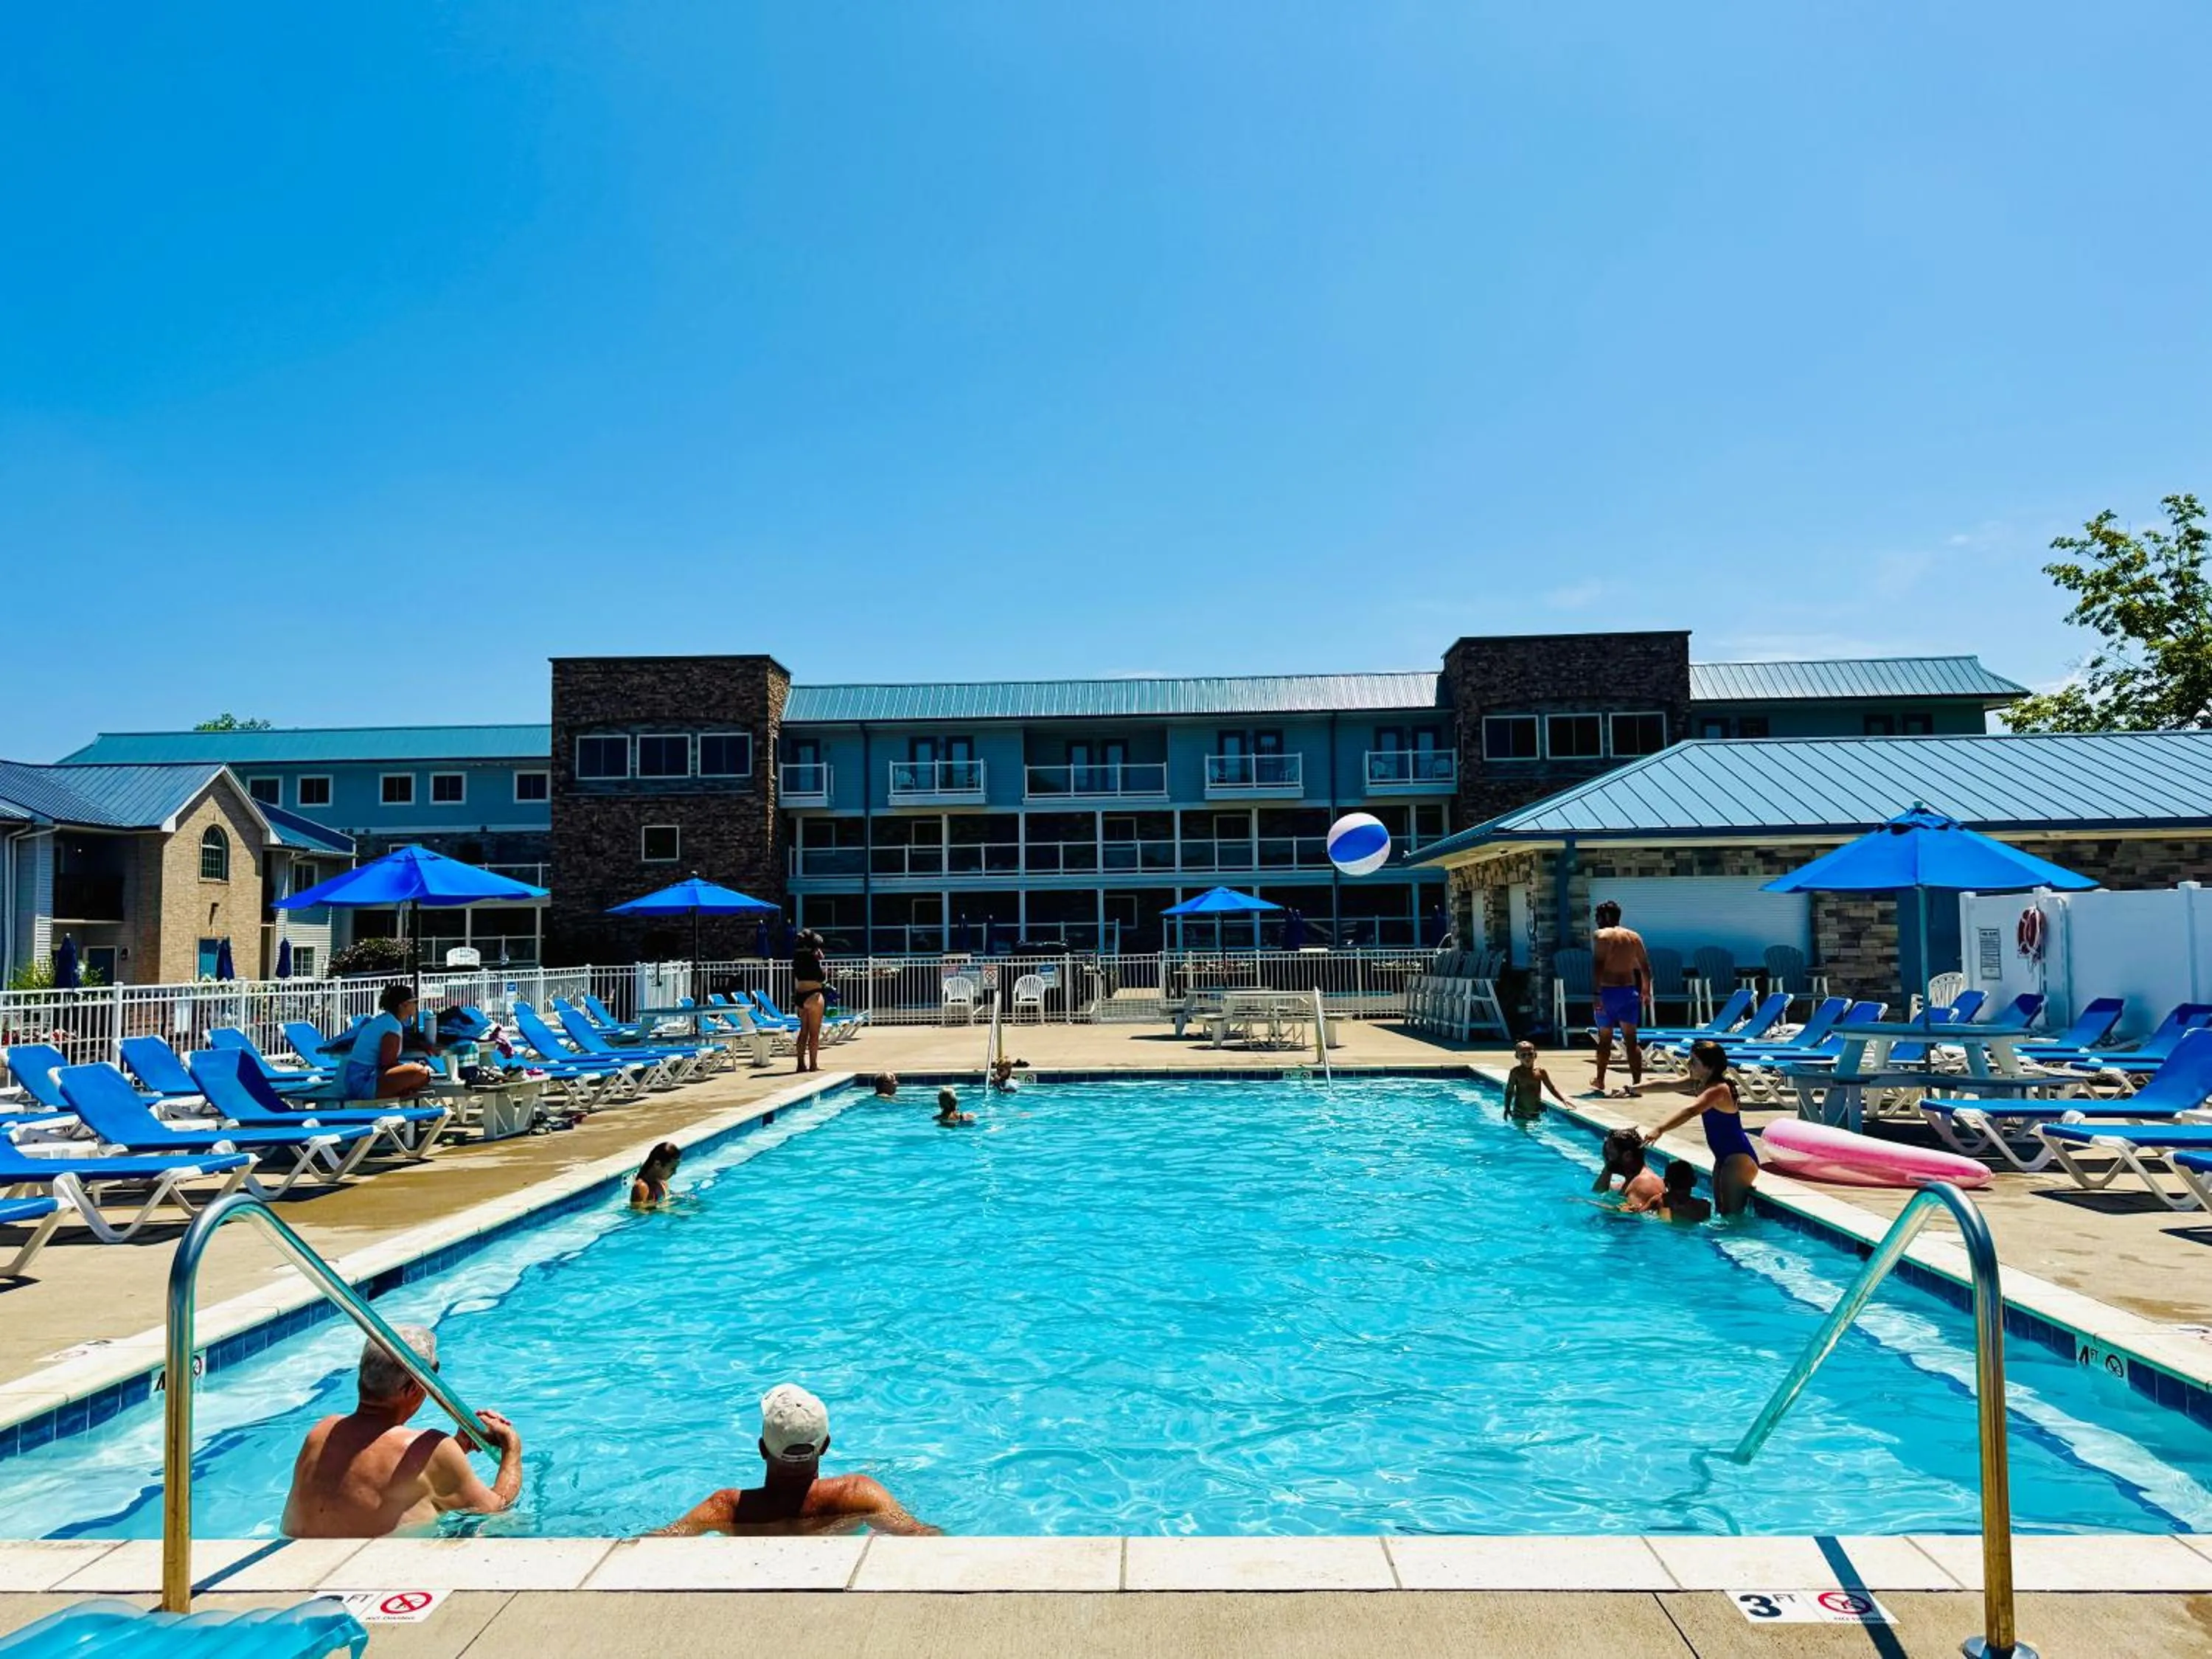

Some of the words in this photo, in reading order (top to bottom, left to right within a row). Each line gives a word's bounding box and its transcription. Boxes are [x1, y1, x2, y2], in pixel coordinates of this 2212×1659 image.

[346, 1593, 374, 1603] FT
[1739, 1594, 1782, 1618] 3
[1772, 1593, 1796, 1603] FT
